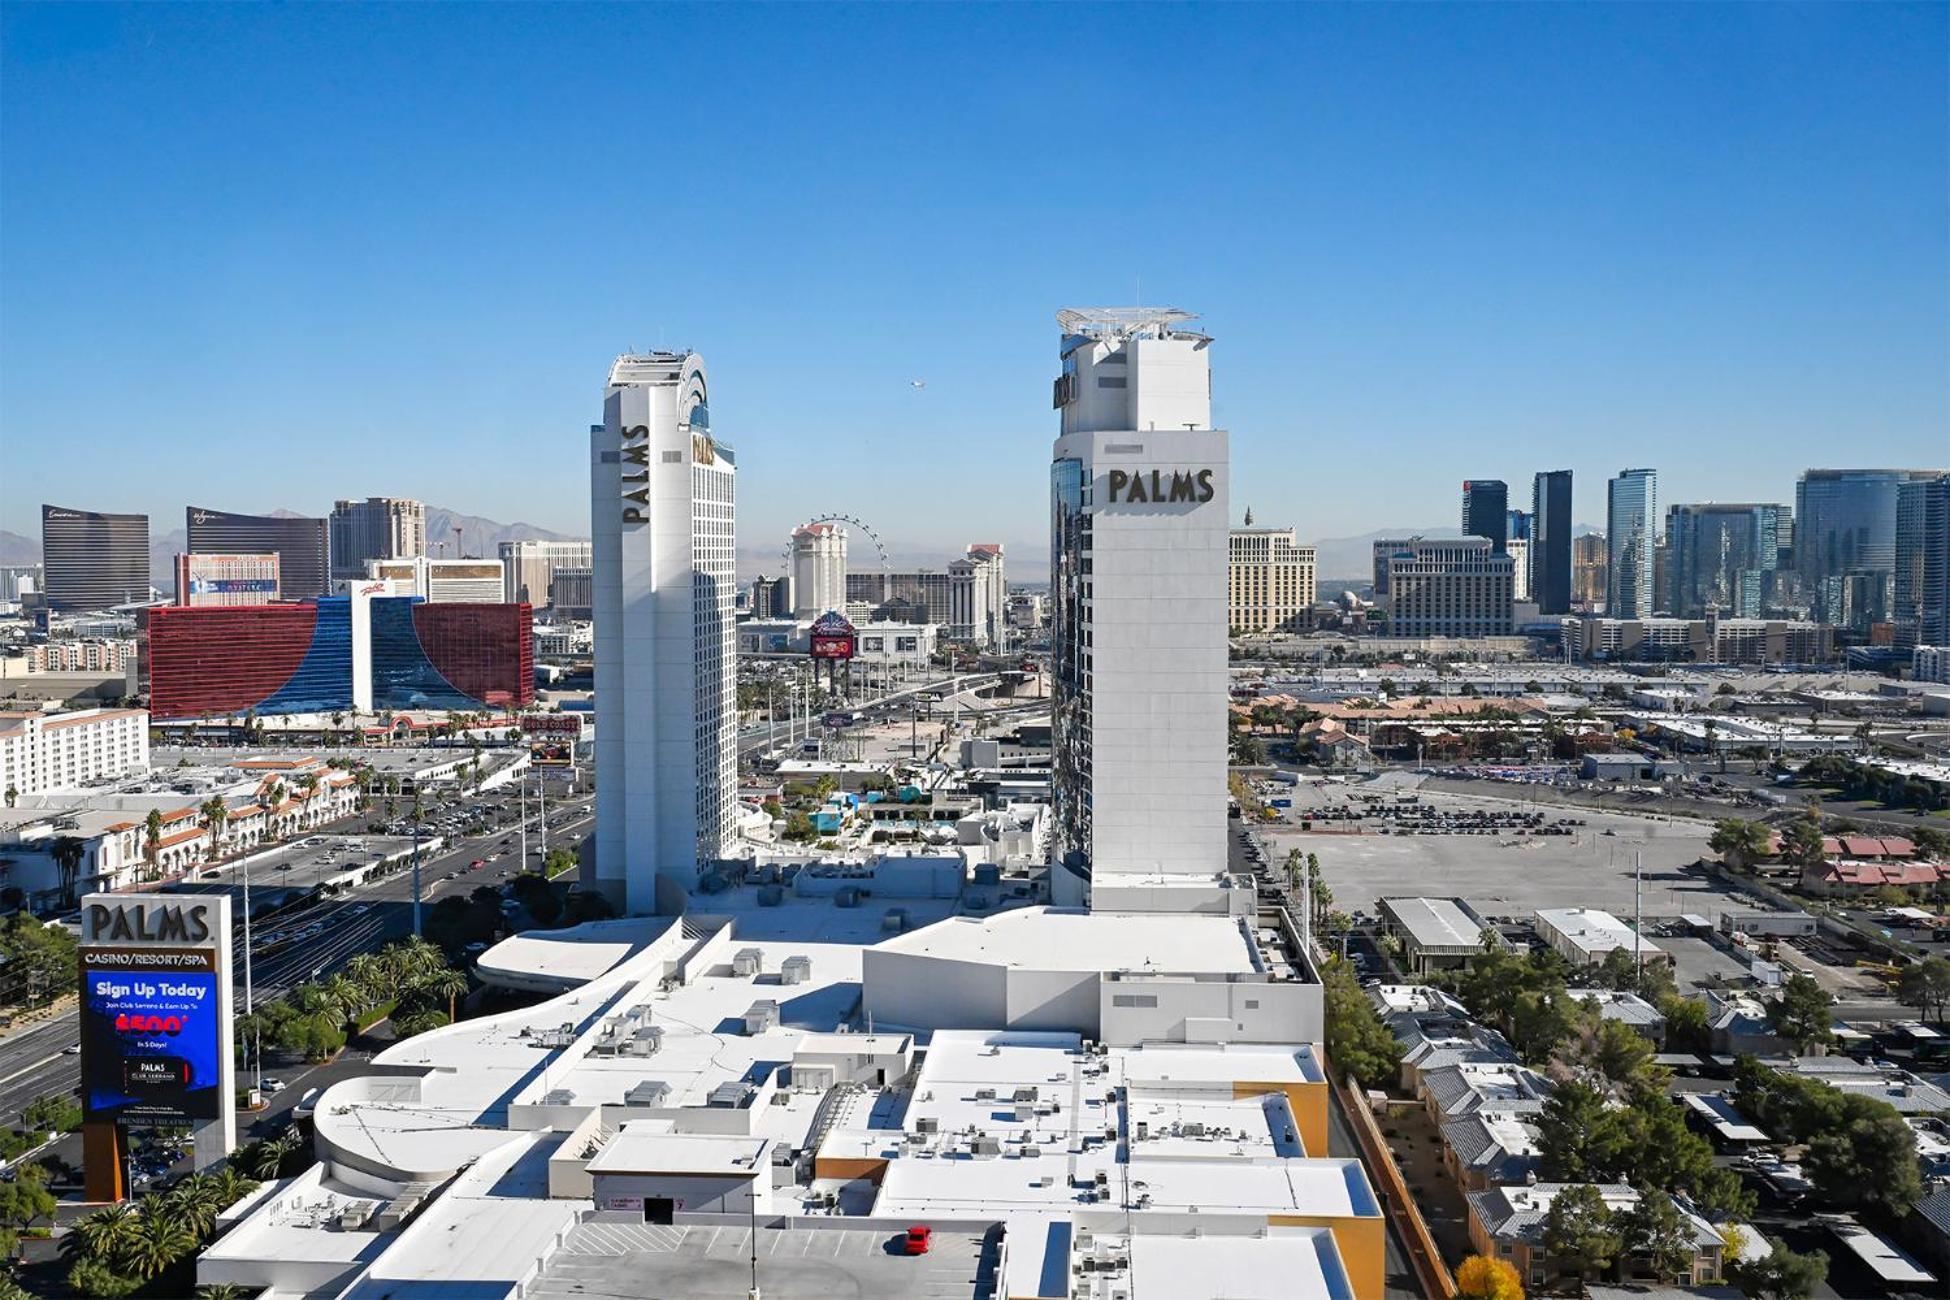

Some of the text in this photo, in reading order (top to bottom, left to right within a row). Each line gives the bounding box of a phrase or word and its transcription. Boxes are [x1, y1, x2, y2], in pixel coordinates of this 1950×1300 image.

[621, 425, 649, 523] PALMS
[1109, 469, 1214, 503] PALMS
[91, 904, 209, 942] PALMS
[85, 953, 208, 966] CASINO/RESORT/SPA
[96, 981, 206, 1000] Sign Up Today
[140, 1063, 165, 1072] PALMS
